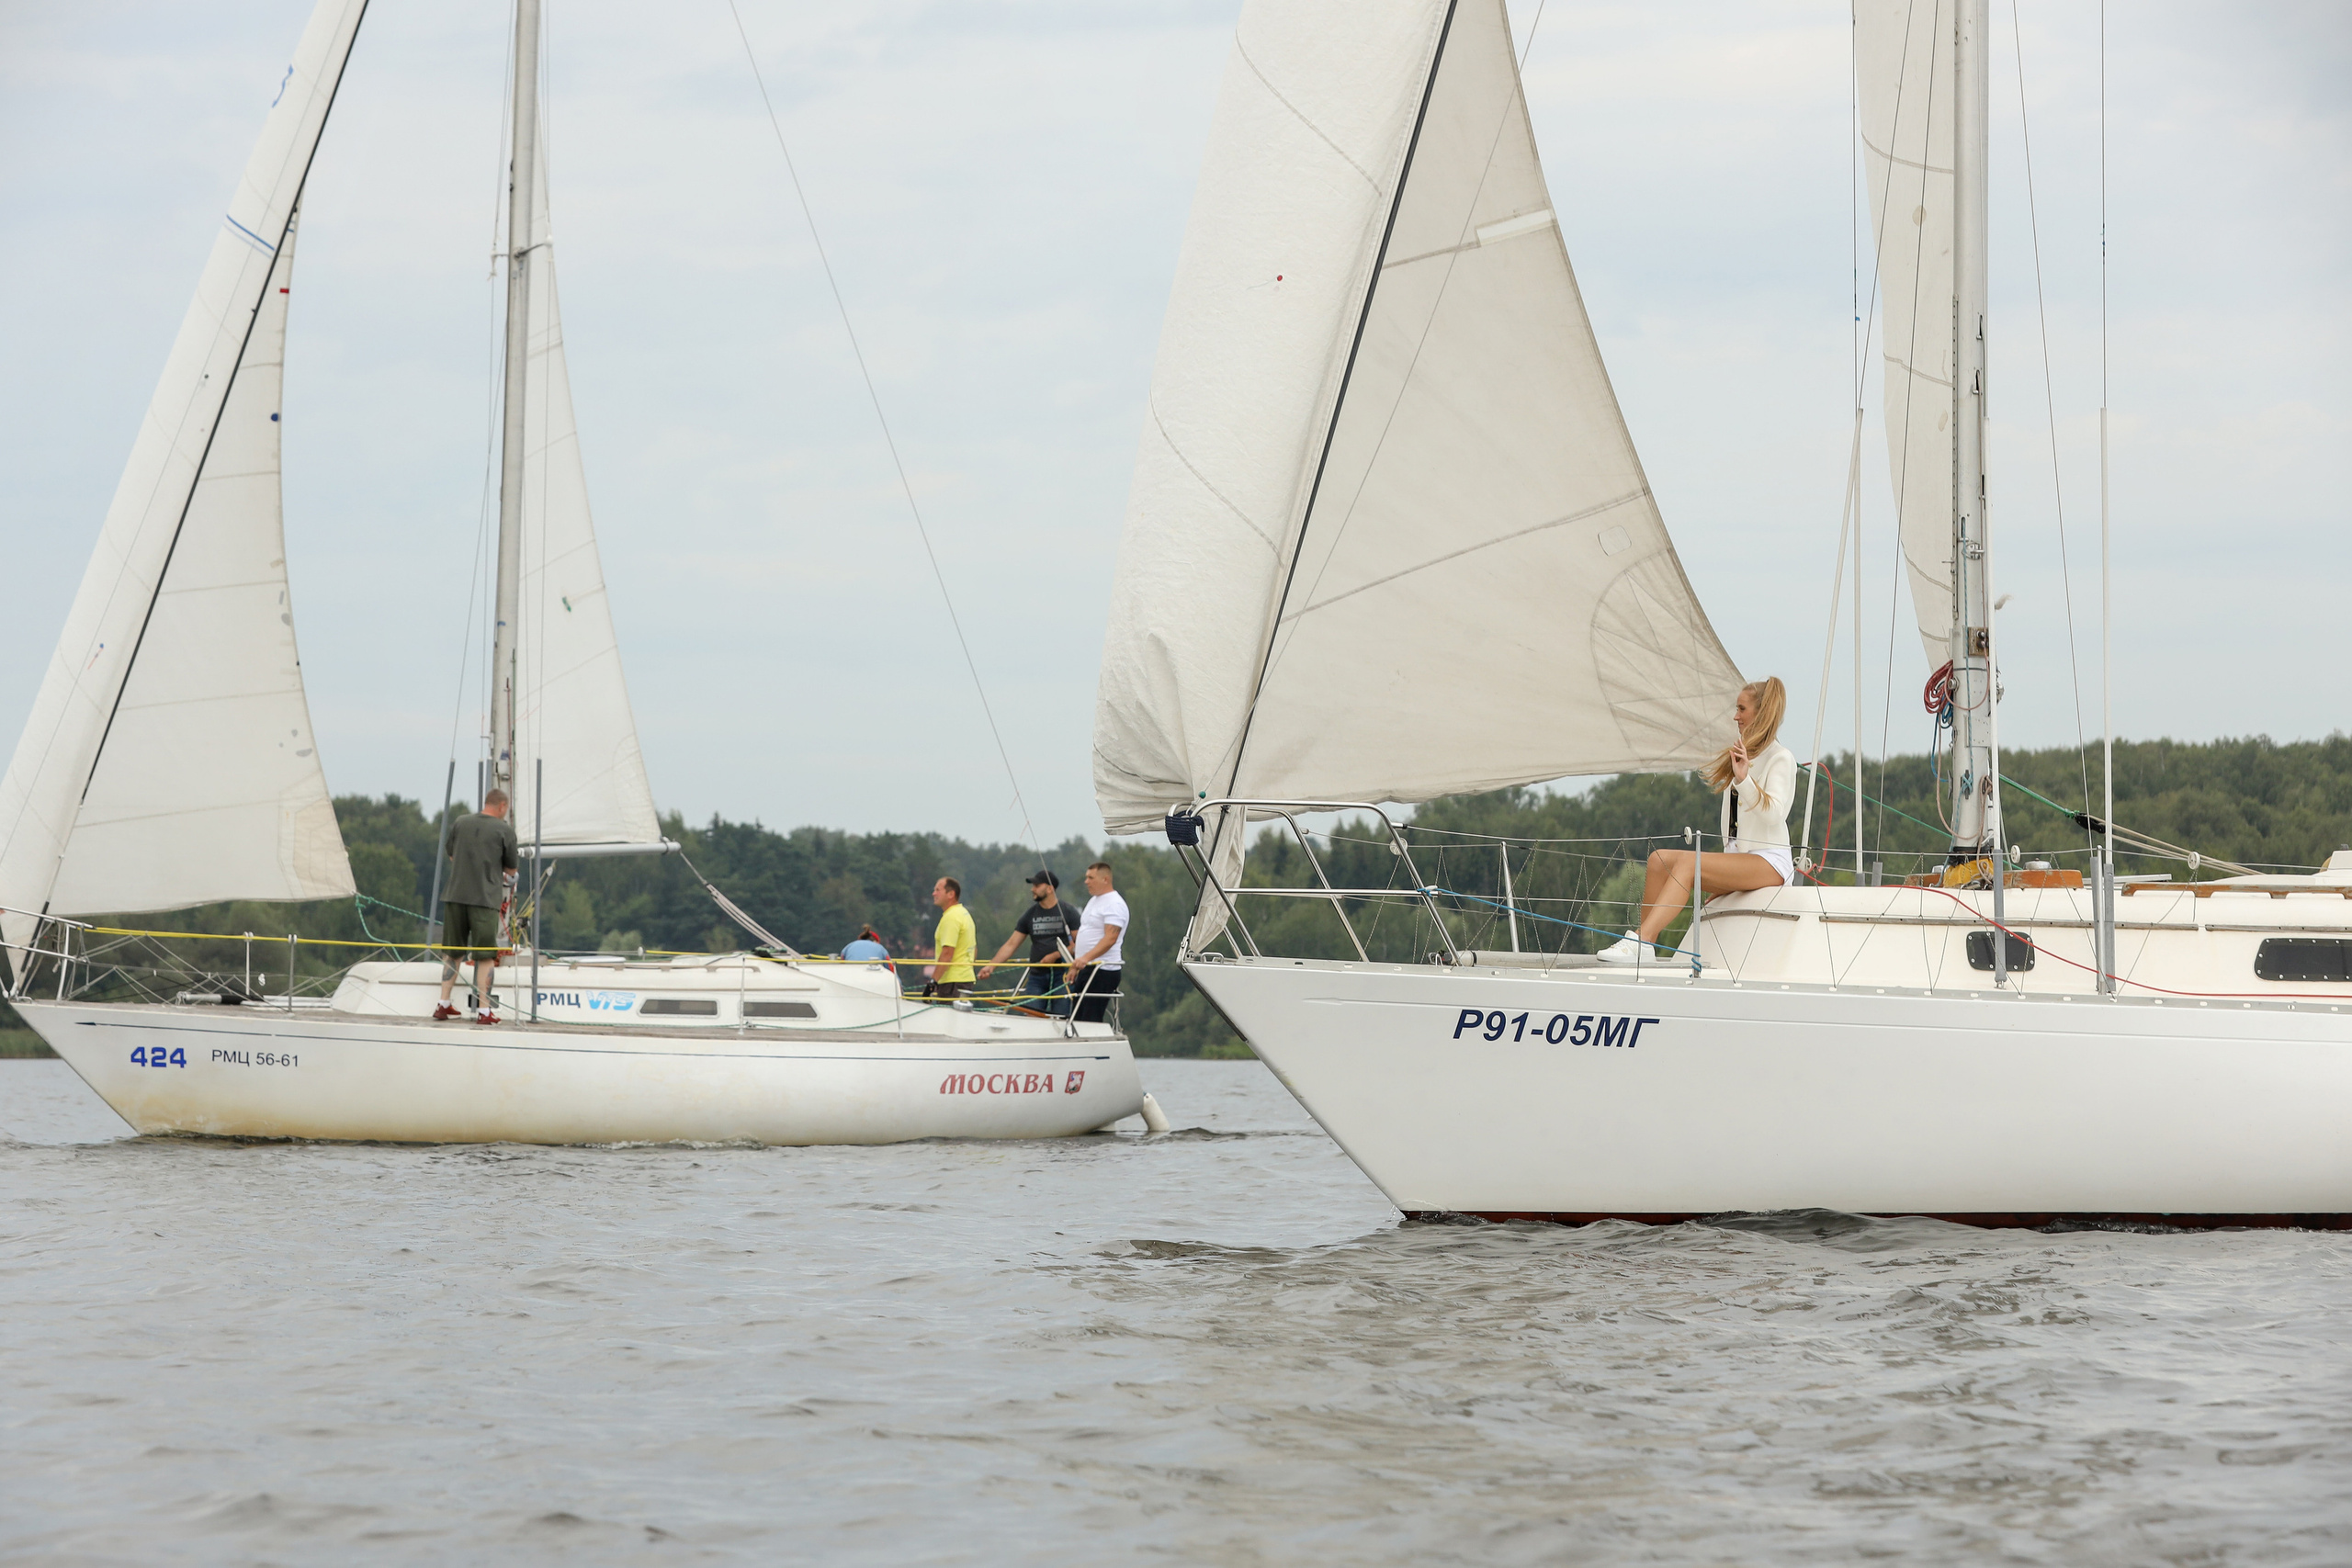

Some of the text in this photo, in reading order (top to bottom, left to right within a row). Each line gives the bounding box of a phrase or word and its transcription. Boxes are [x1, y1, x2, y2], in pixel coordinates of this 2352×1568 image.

[537, 992, 581, 1009] РМЦ
[1453, 1009, 1660, 1048] Р91-05МГ
[130, 1046, 187, 1068] 424
[211, 1049, 299, 1067] РМЦ 56-61
[939, 1073, 1054, 1095] МОСКВА
